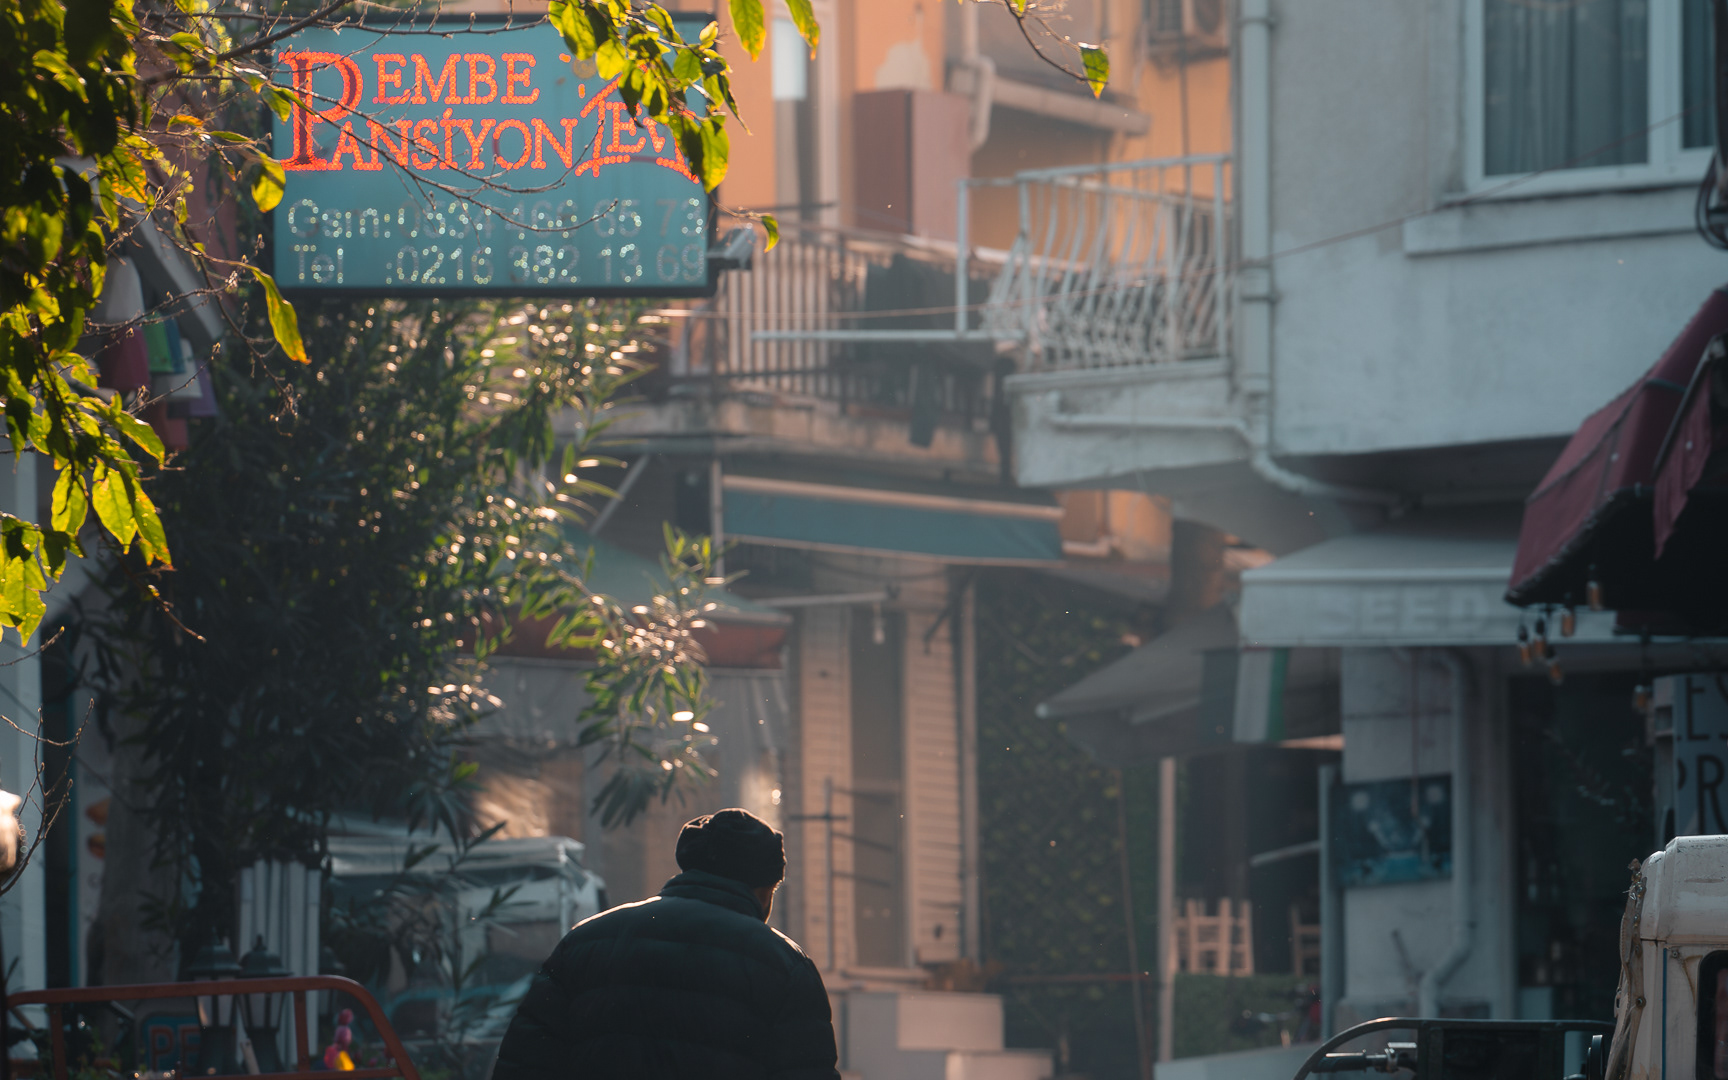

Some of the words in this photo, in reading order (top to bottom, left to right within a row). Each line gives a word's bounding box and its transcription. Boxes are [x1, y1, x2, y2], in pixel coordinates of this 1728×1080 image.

[592, 198, 642, 239] 65
[654, 198, 703, 239] 73
[289, 243, 345, 284] Tel
[507, 244, 580, 284] 382
[598, 244, 642, 284] 13
[655, 243, 705, 284] 69
